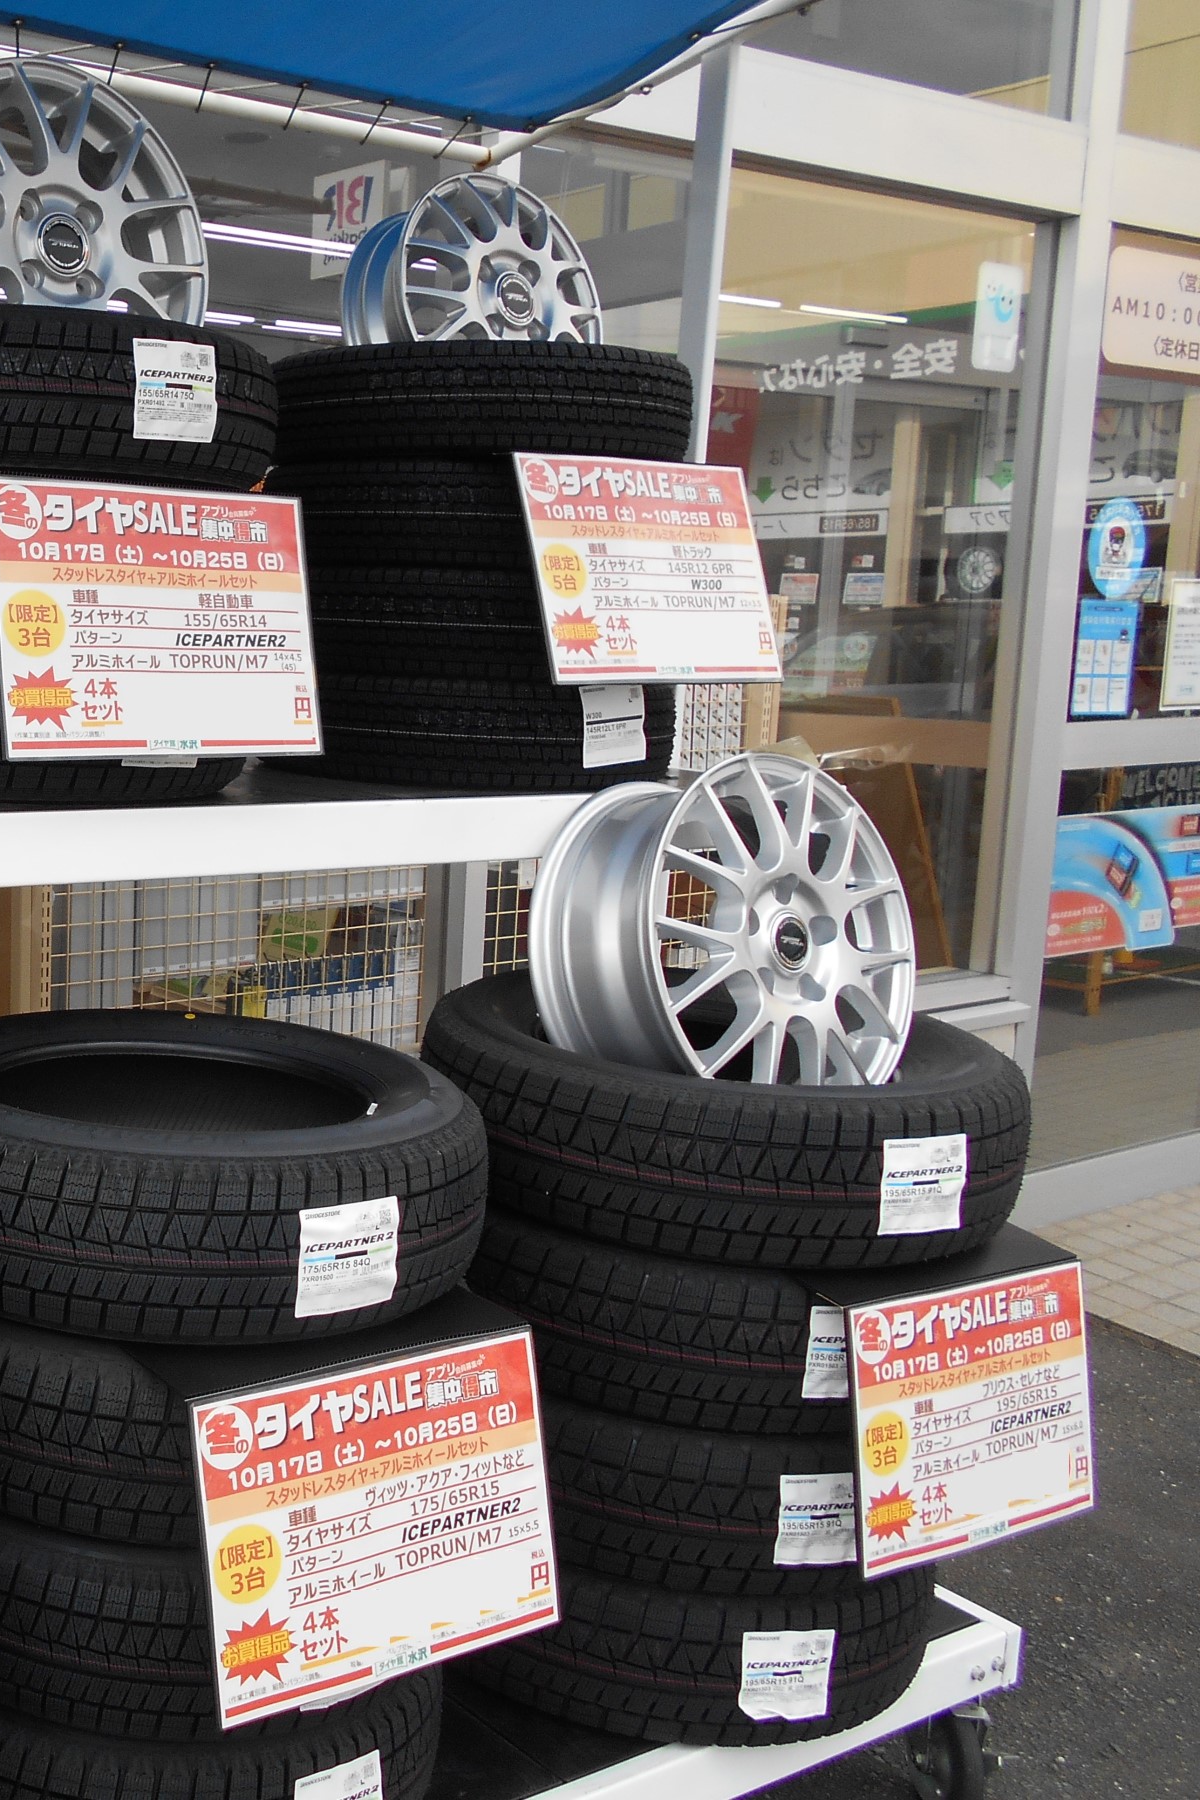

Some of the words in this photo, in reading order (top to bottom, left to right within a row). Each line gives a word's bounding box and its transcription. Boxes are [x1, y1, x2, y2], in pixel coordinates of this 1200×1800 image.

[139, 390, 178, 399] 155/65R14
[181, 392, 194, 400] 75Q
[672, 546, 712, 558] 軽トラック
[589, 560, 646, 573] タイヤサイズ
[668, 562, 708, 574] 145R12
[711, 563, 734, 574] 6PR
[552, 576, 578, 591] 5台
[691, 579, 723, 591] W300
[72, 589, 99, 604] 車種
[198, 593, 254, 609] 軽自動車
[593, 595, 658, 608] アルミホイール
[663, 596, 736, 610] TOPRUN/M7
[70, 609, 149, 627] タイヤサイズ
[184, 613, 268, 628] 155/65R14
[606, 614, 630, 632] 4本
[17, 627, 51, 648] 3台
[74, 631, 123, 645] パターン
[175, 632, 287, 648] ICEPARTNER2
[553, 623, 600, 640] お買得品
[605, 633, 638, 650] セット
[758, 632, 773, 650] 円
[71, 654, 161, 669] アルミホイール
[169, 654, 268, 671] TOPRUN/M7
[8, 688, 73, 707] お買得品
[83, 678, 118, 698] 4本
[81, 701, 124, 721] セット
[294, 697, 312, 719] 円
[302, 1261, 350, 1274] 175/65R15
[353, 1258, 371, 1268] 84Q
[912, 1406, 972, 1434] タイヤサイズ
[996, 1385, 1058, 1413] 195/65R15
[915, 1435, 952, 1454] パターン
[990, 1401, 1072, 1434] ICEPARTNER2
[872, 1446, 898, 1469] 3台
[913, 1449, 980, 1479] アルミホイール
[985, 1424, 1059, 1457] TOPRUN/M7
[918, 1504, 953, 1527] セット
[1075, 1457, 1089, 1478] 円
[922, 1482, 948, 1503] 4本
[286, 1513, 372, 1549] タイヤサイズ
[410, 1481, 500, 1518] 175/65R15
[288, 1508, 318, 1527] 車種
[866, 1499, 914, 1528] お買得品
[291, 1550, 344, 1575] パターン
[401, 1497, 522, 1543] ICEPARTNER2
[288, 1563, 386, 1605] アルミホイール
[394, 1527, 503, 1571] TOPRUN/M7
[229, 1567, 267, 1597] 3台
[299, 1628, 349, 1662] セット
[530, 1562, 550, 1590] 円
[302, 1605, 340, 1634] 4本
[221, 1629, 292, 1669] お買得品
[407, 1647, 429, 1665] 水沢
